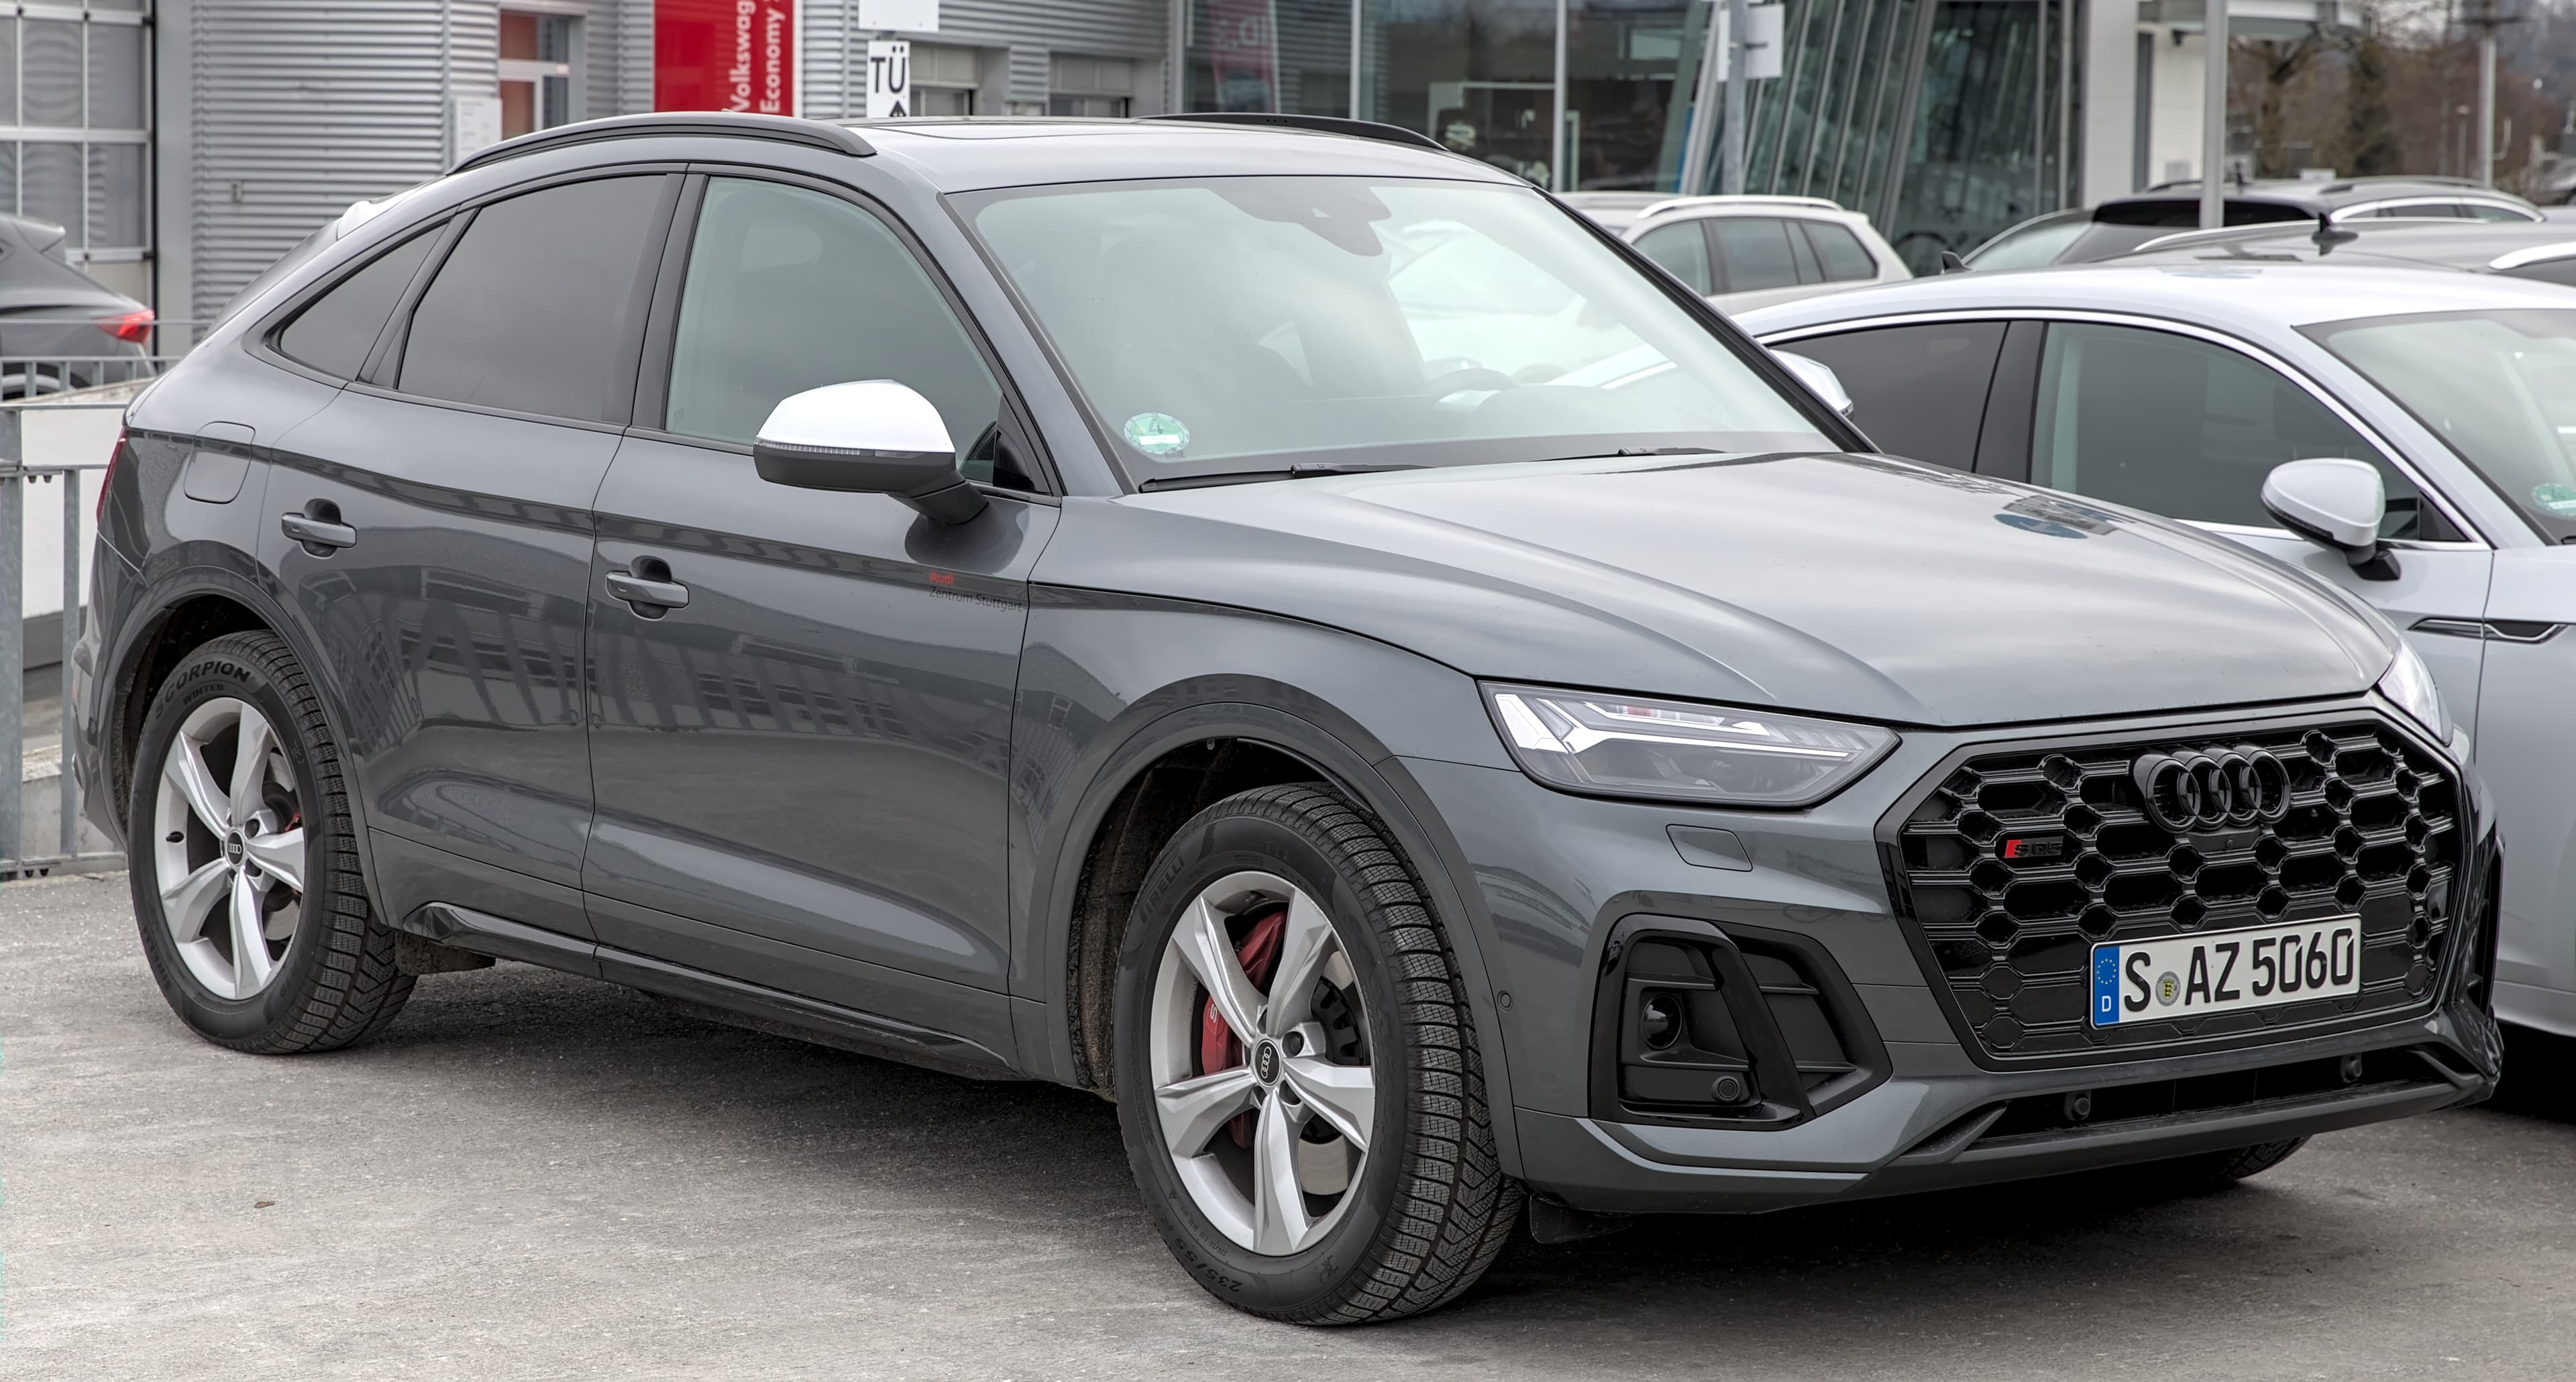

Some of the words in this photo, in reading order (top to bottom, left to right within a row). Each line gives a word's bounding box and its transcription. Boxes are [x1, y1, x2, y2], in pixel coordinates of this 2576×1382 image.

[759, 7, 786, 113] Economy
[929, 570, 955, 585] Audi
[929, 586, 972, 603] Zentrum
[975, 594, 1022, 612] Stuttgart
[155, 661, 251, 719] SCORPION
[182, 684, 224, 705] WINTER
[2102, 996, 2111, 1012] D
[2125, 951, 2151, 1012] S
[2185, 941, 2240, 1006] AZ
[2252, 928, 2354, 996] 5060
[1175, 1238, 1242, 1292] 235/55
